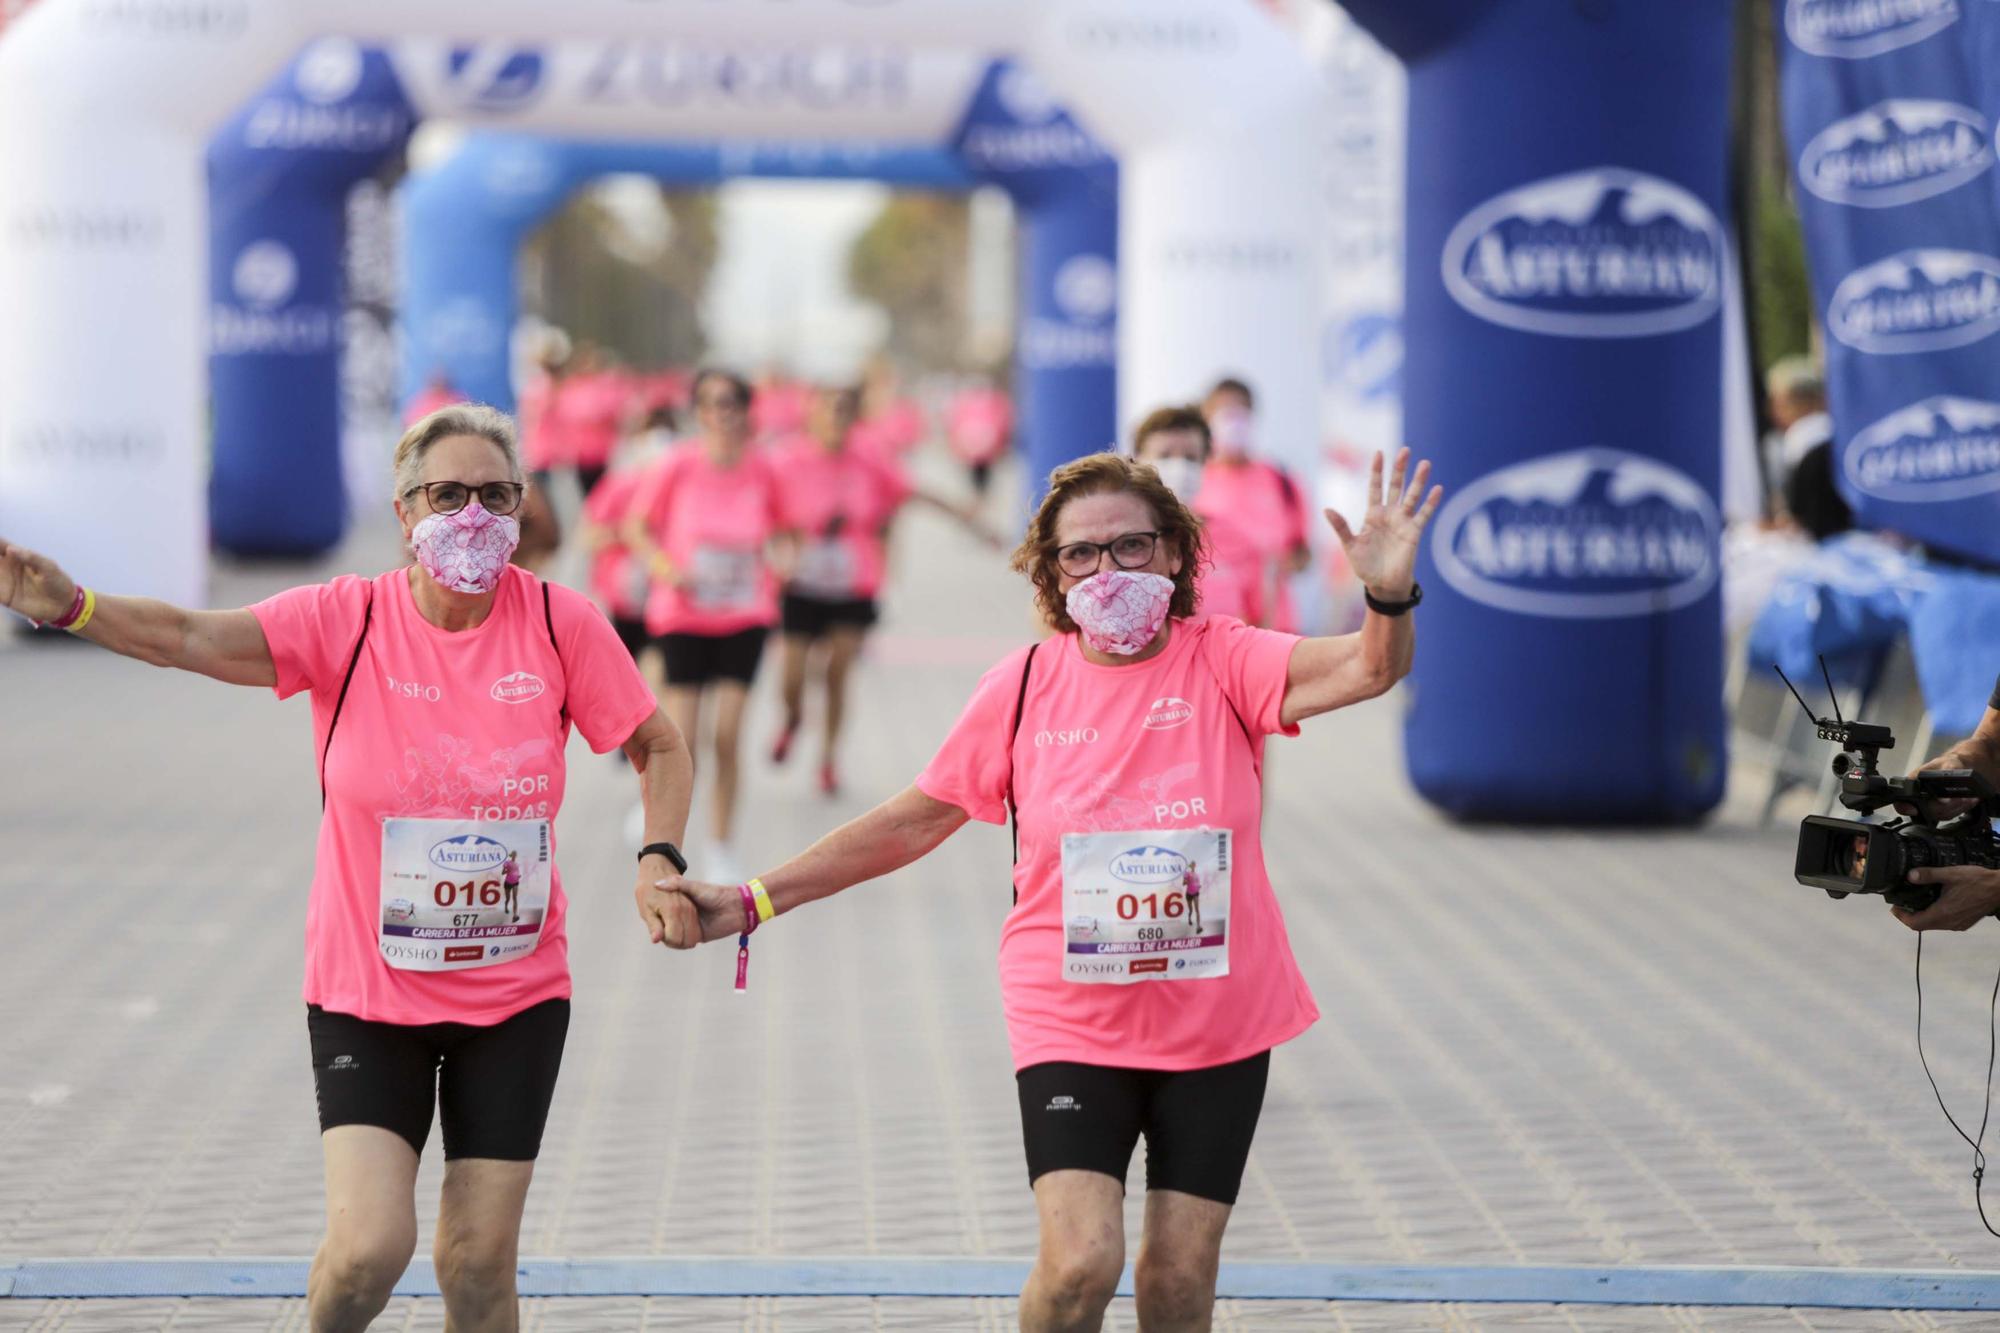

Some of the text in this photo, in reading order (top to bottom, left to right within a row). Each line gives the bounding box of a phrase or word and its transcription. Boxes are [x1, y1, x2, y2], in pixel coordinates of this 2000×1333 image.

[1034, 727, 1099, 748] OYSHO
[503, 774, 548, 796] POR
[471, 801, 547, 822] TODAS
[1154, 797, 1207, 824] POR
[435, 848, 502, 864] ASTURIANA
[1116, 861, 1183, 876] ASTURIANA
[433, 880, 501, 907] 016
[1116, 892, 1184, 920] 016
[453, 914, 479, 927] 677
[411, 926, 517, 938] CARRERA DE LA MUJER
[1137, 927, 1164, 940] 680
[385, 944, 438, 961] OYSHO
[1096, 937, 1202, 954] CARRERA DE LA MUJER
[1070, 962, 1123, 974] OYSHO
